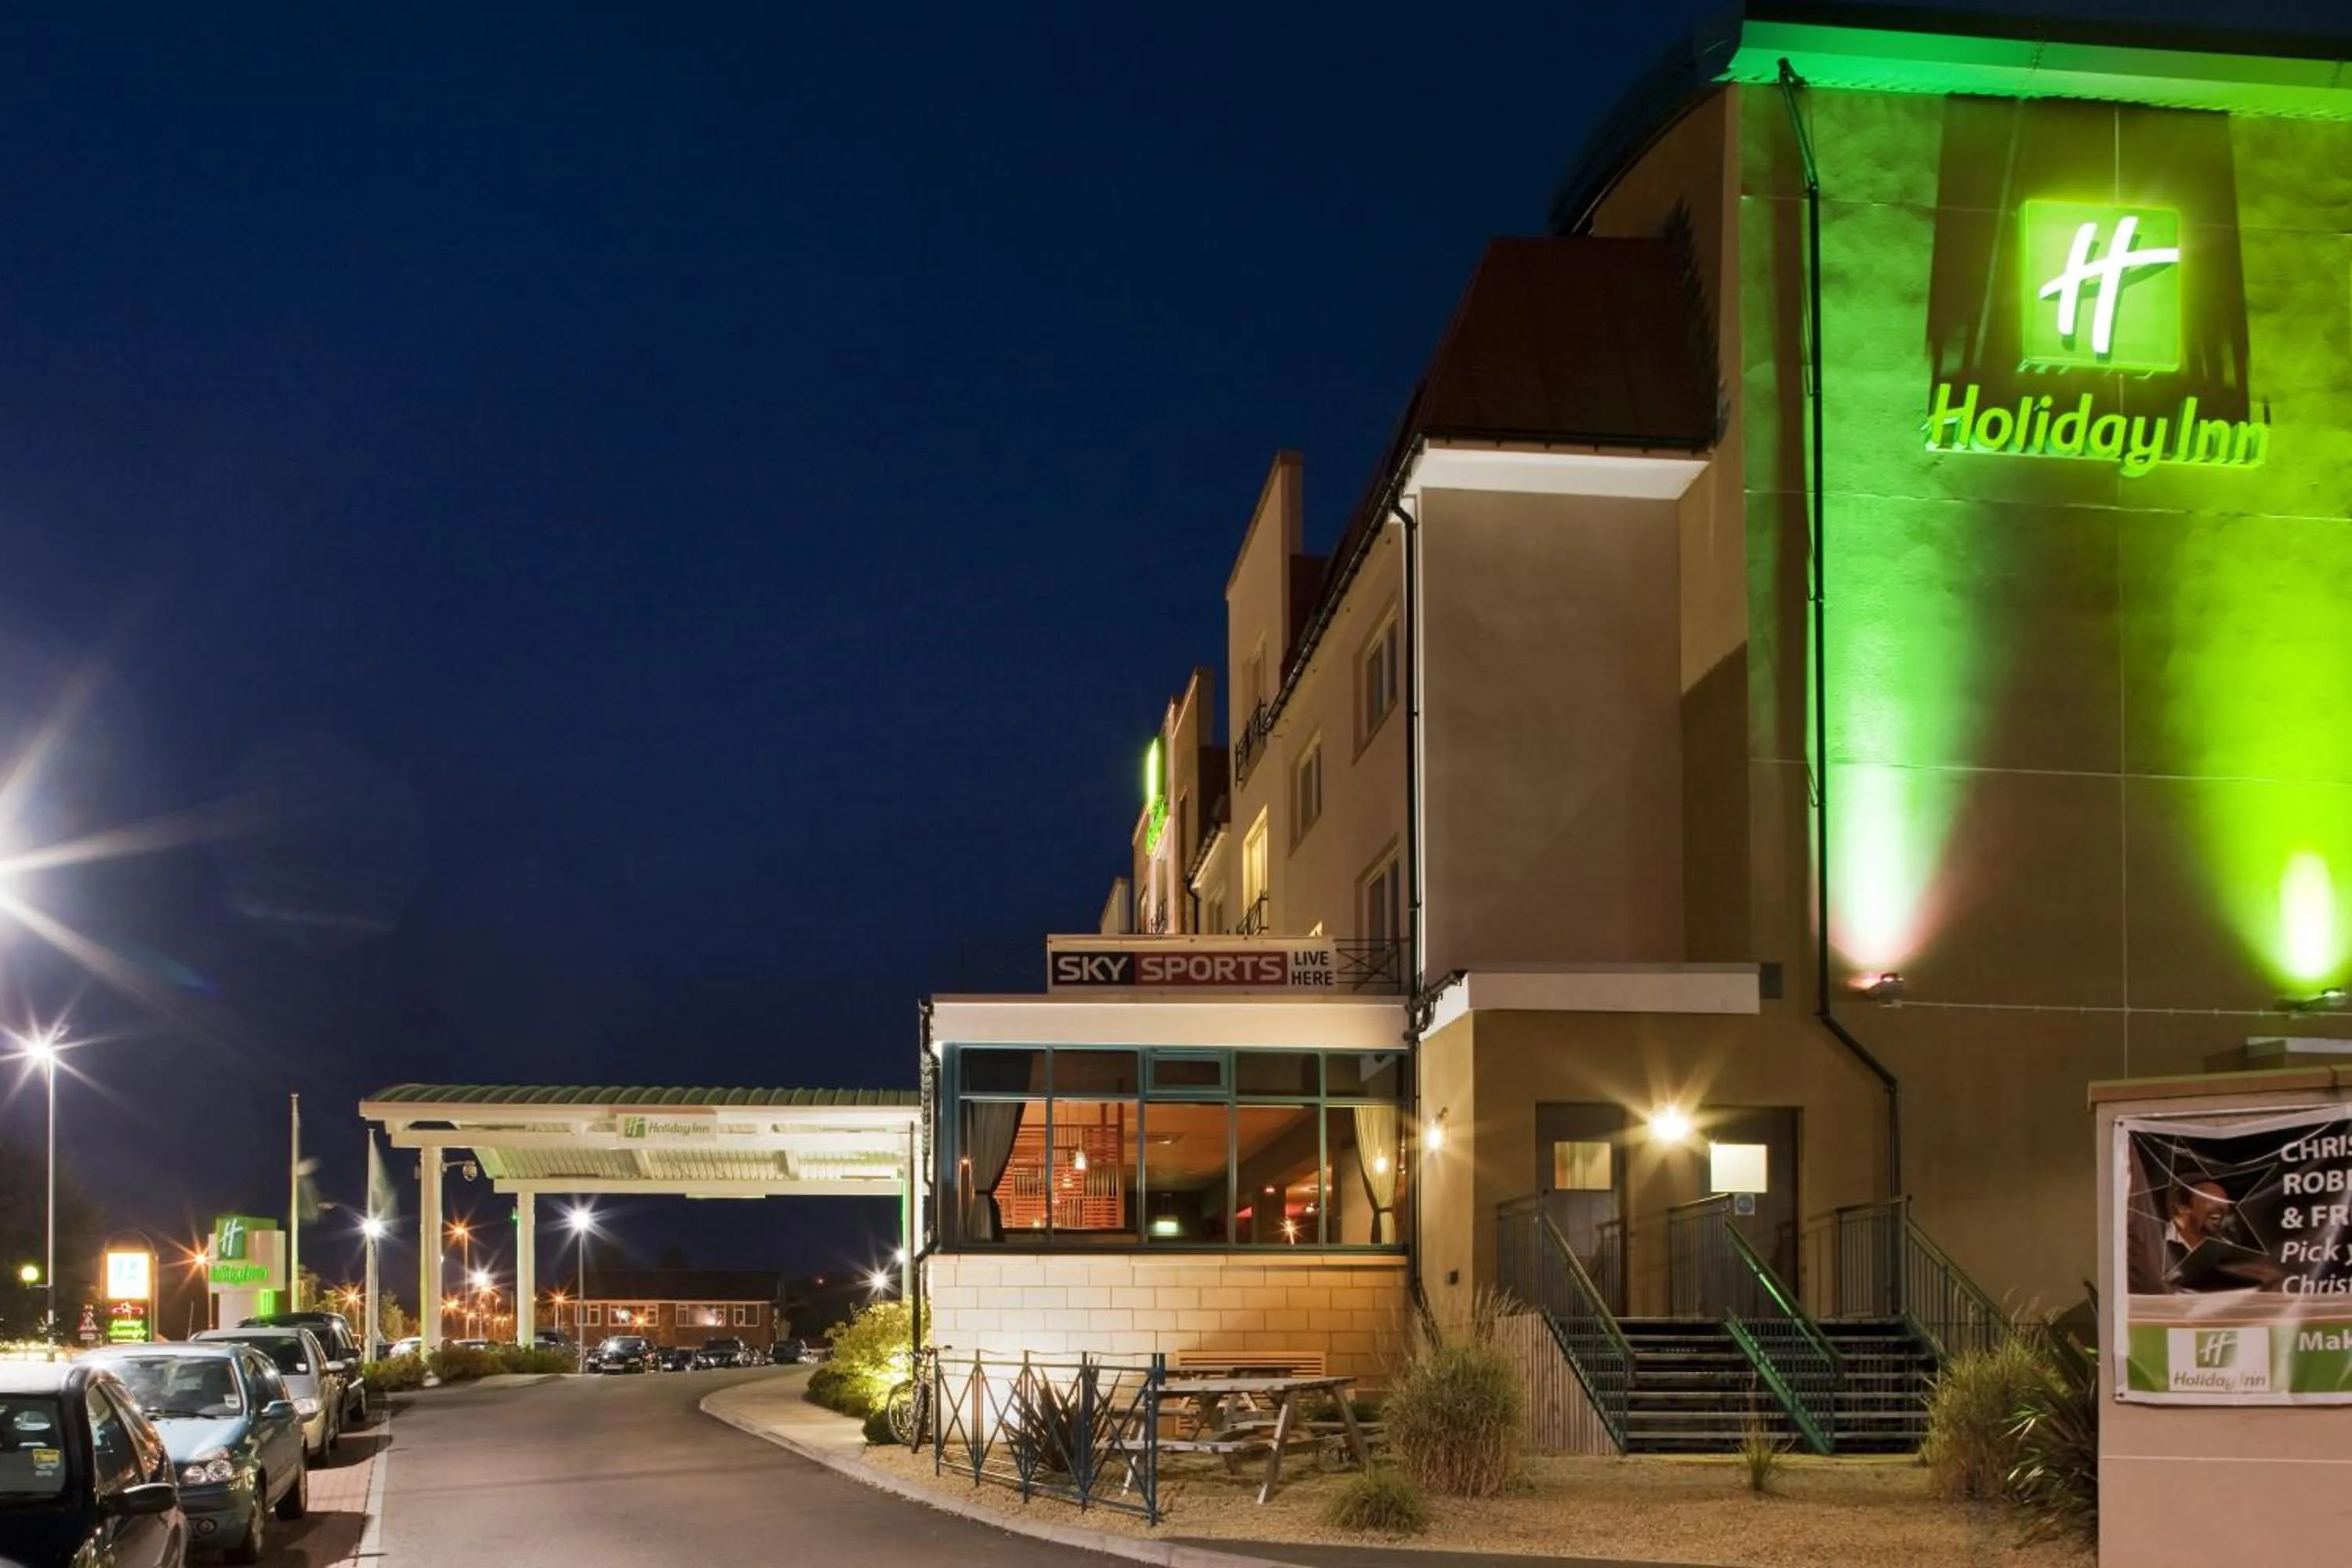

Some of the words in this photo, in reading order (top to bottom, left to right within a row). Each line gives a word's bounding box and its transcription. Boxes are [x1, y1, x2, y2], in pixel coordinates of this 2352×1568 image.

[1922, 383, 2169, 479] Holiday
[2176, 397, 2271, 468] Inn
[1057, 955, 1129, 982] SKY
[1140, 955, 1283, 982] SPORTS
[1294, 951, 1330, 967] LIVE
[1290, 970, 1334, 986] HERE
[2281, 1207, 2304, 1229] &
[2280, 1237, 2341, 1264] Pick
[2173, 1370, 2236, 1391] Holiday
